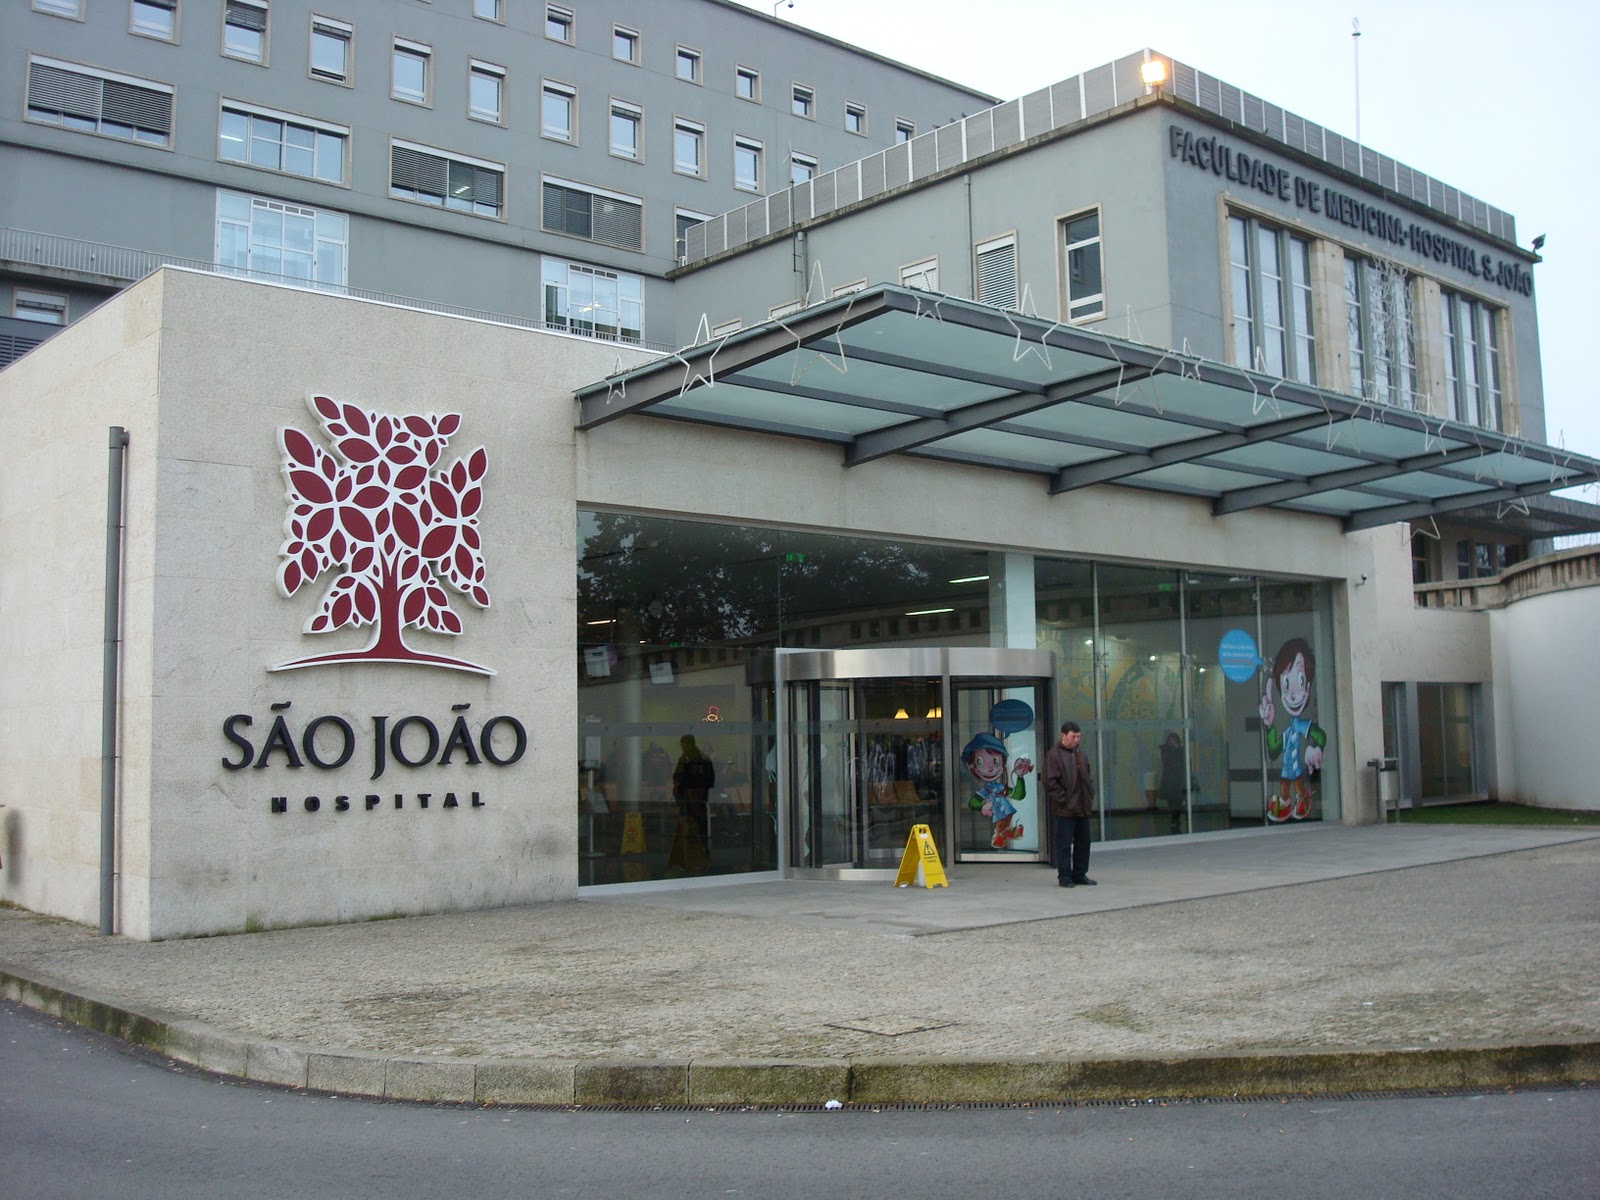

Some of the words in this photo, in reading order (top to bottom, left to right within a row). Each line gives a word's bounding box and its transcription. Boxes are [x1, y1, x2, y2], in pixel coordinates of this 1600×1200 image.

[1169, 125, 1291, 202] FACULDADE
[1294, 176, 1321, 214] DE
[222, 701, 355, 770] SÃO
[370, 703, 527, 780] JOÃO
[271, 791, 485, 814] HOSPITAL
